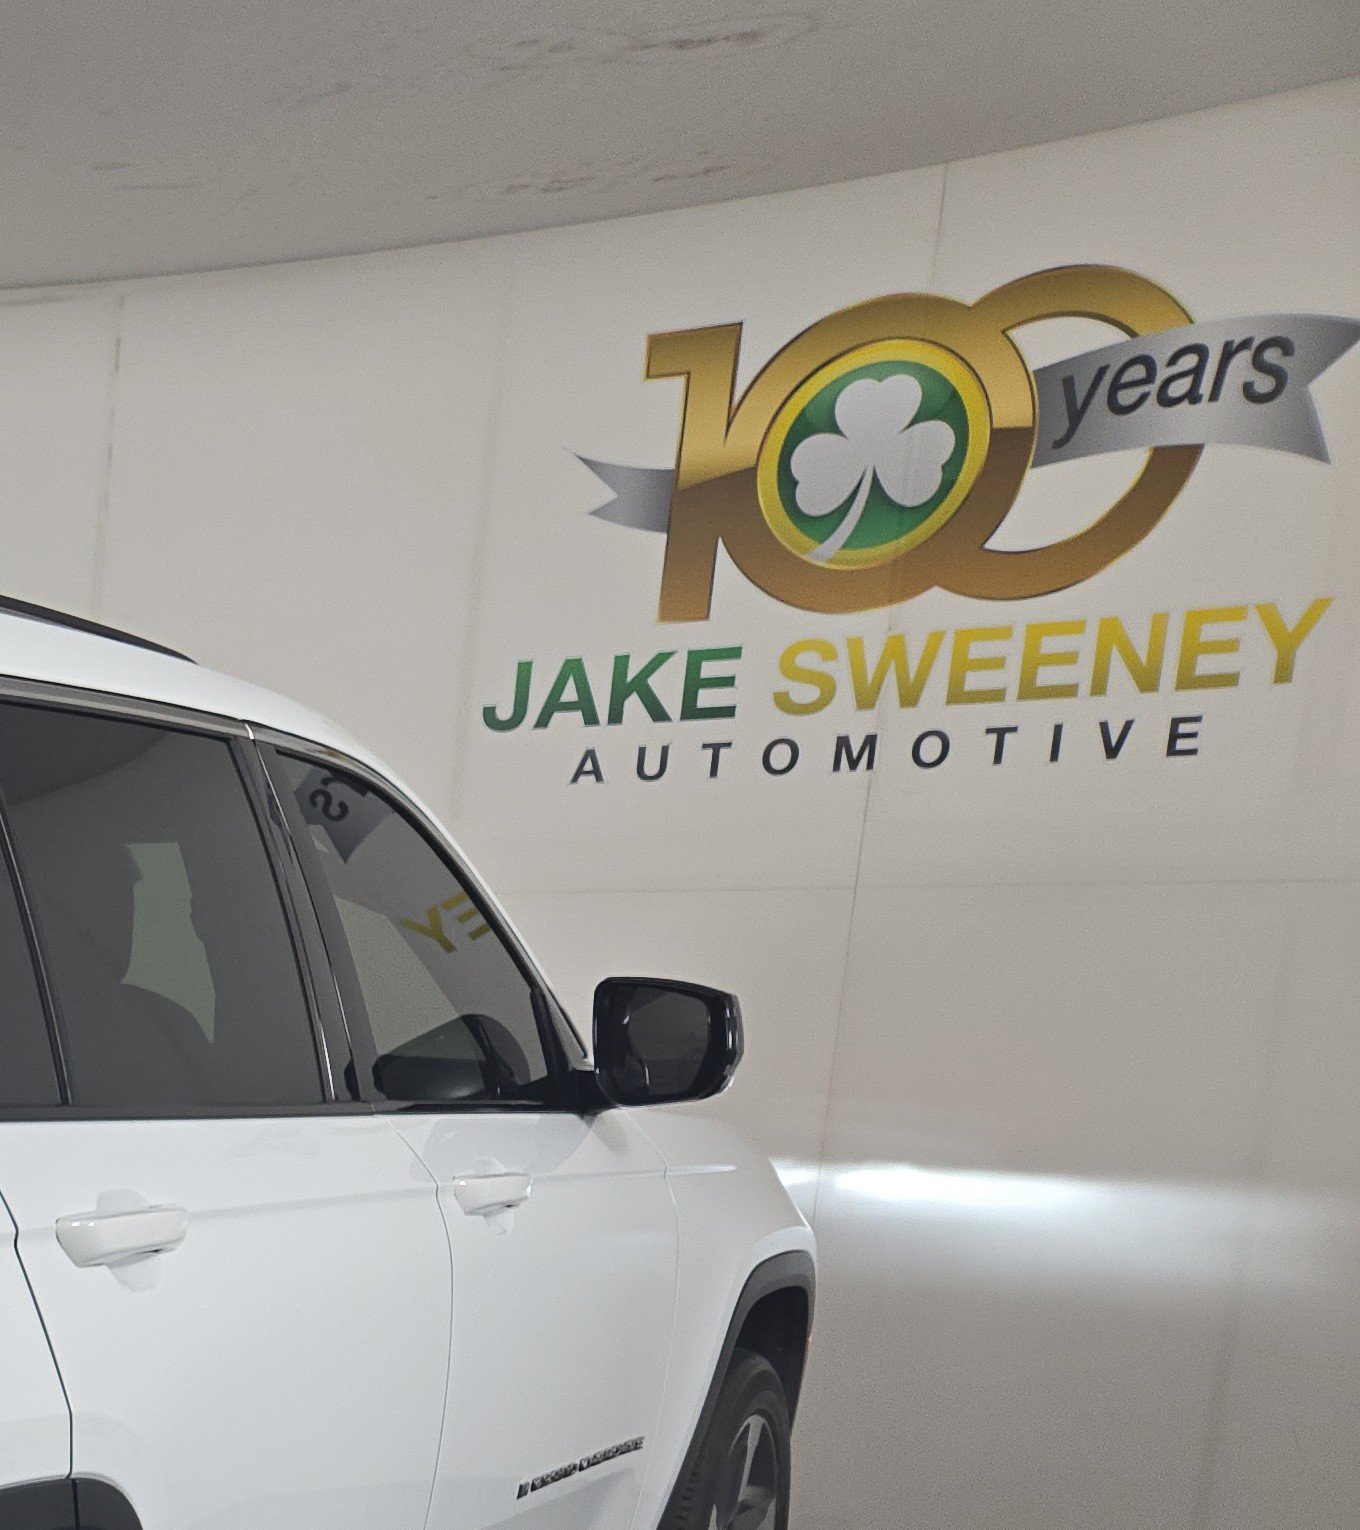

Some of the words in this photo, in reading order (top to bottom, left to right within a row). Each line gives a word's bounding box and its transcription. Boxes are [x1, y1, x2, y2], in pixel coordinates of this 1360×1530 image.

[646, 263, 1204, 624] 100
[1053, 334, 1295, 449] years
[481, 645, 743, 733] JAKE
[771, 597, 1335, 718] SWEENEY
[569, 716, 1205, 785] AUTOMOTIVE
